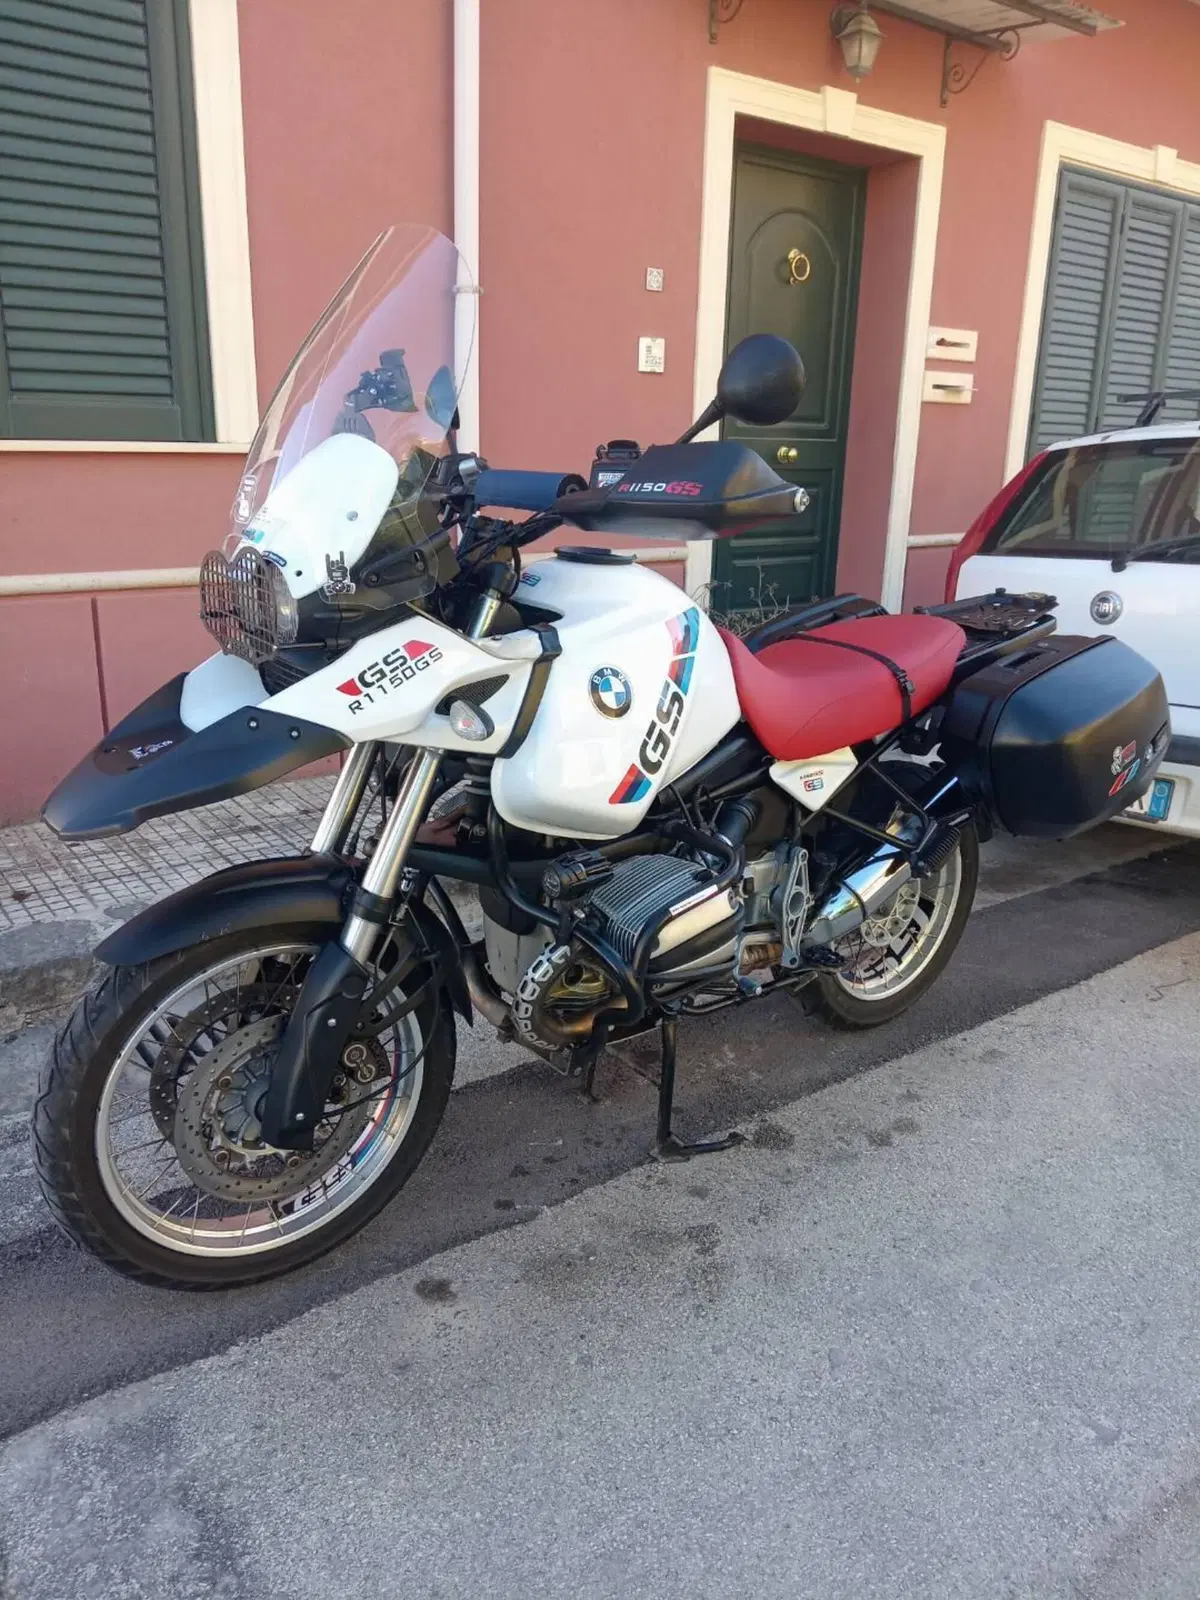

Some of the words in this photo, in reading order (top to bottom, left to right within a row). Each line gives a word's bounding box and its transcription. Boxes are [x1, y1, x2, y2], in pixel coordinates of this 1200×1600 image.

[348, 647, 443, 715] R1150GS
[357, 648, 408, 689] GS
[592, 667, 627, 687] BMW
[638, 679, 684, 775] GS
